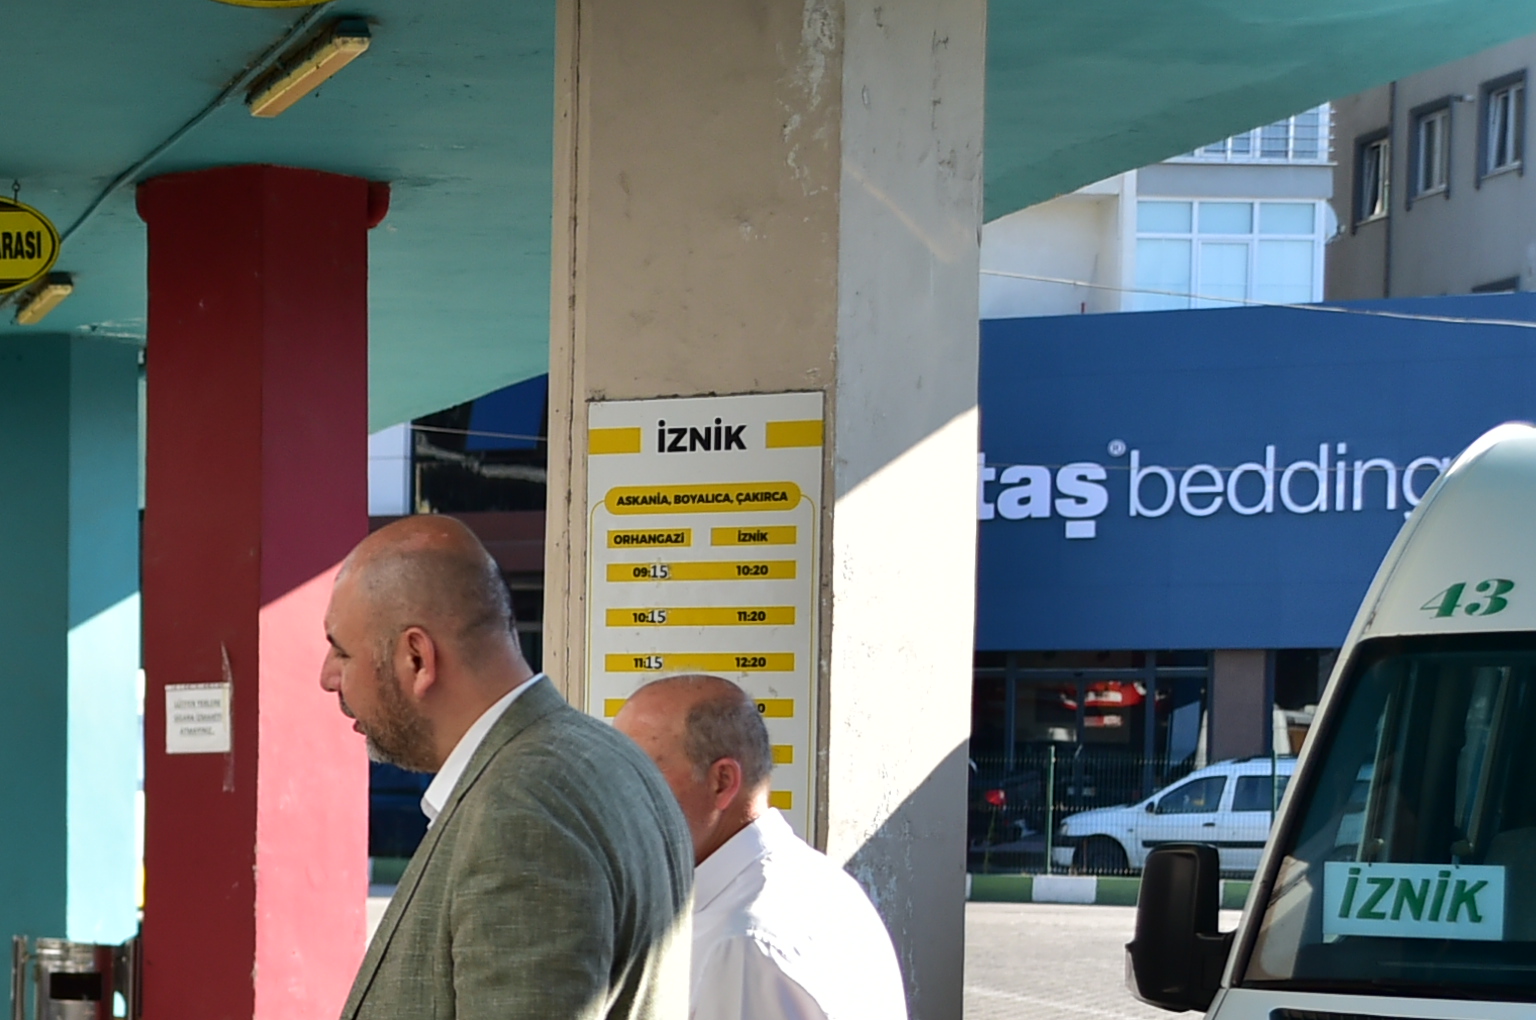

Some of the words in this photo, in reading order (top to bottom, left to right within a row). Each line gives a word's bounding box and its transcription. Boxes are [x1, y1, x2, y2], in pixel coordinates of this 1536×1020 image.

[657, 417, 748, 453] İZNİK
[736, 491, 788, 505] ÇAKIRCA
[737, 530, 768, 542] İZNİK
[633, 565, 668, 579] 09:15
[736, 565, 769, 576] 10:20
[1419, 578, 1515, 618] 43
[633, 610, 667, 624] 10:15
[737, 611, 767, 622] 11:20
[633, 656, 663, 670] 11:15
[735, 656, 767, 668] 12:20
[1338, 867, 1489, 924] İZNİK
